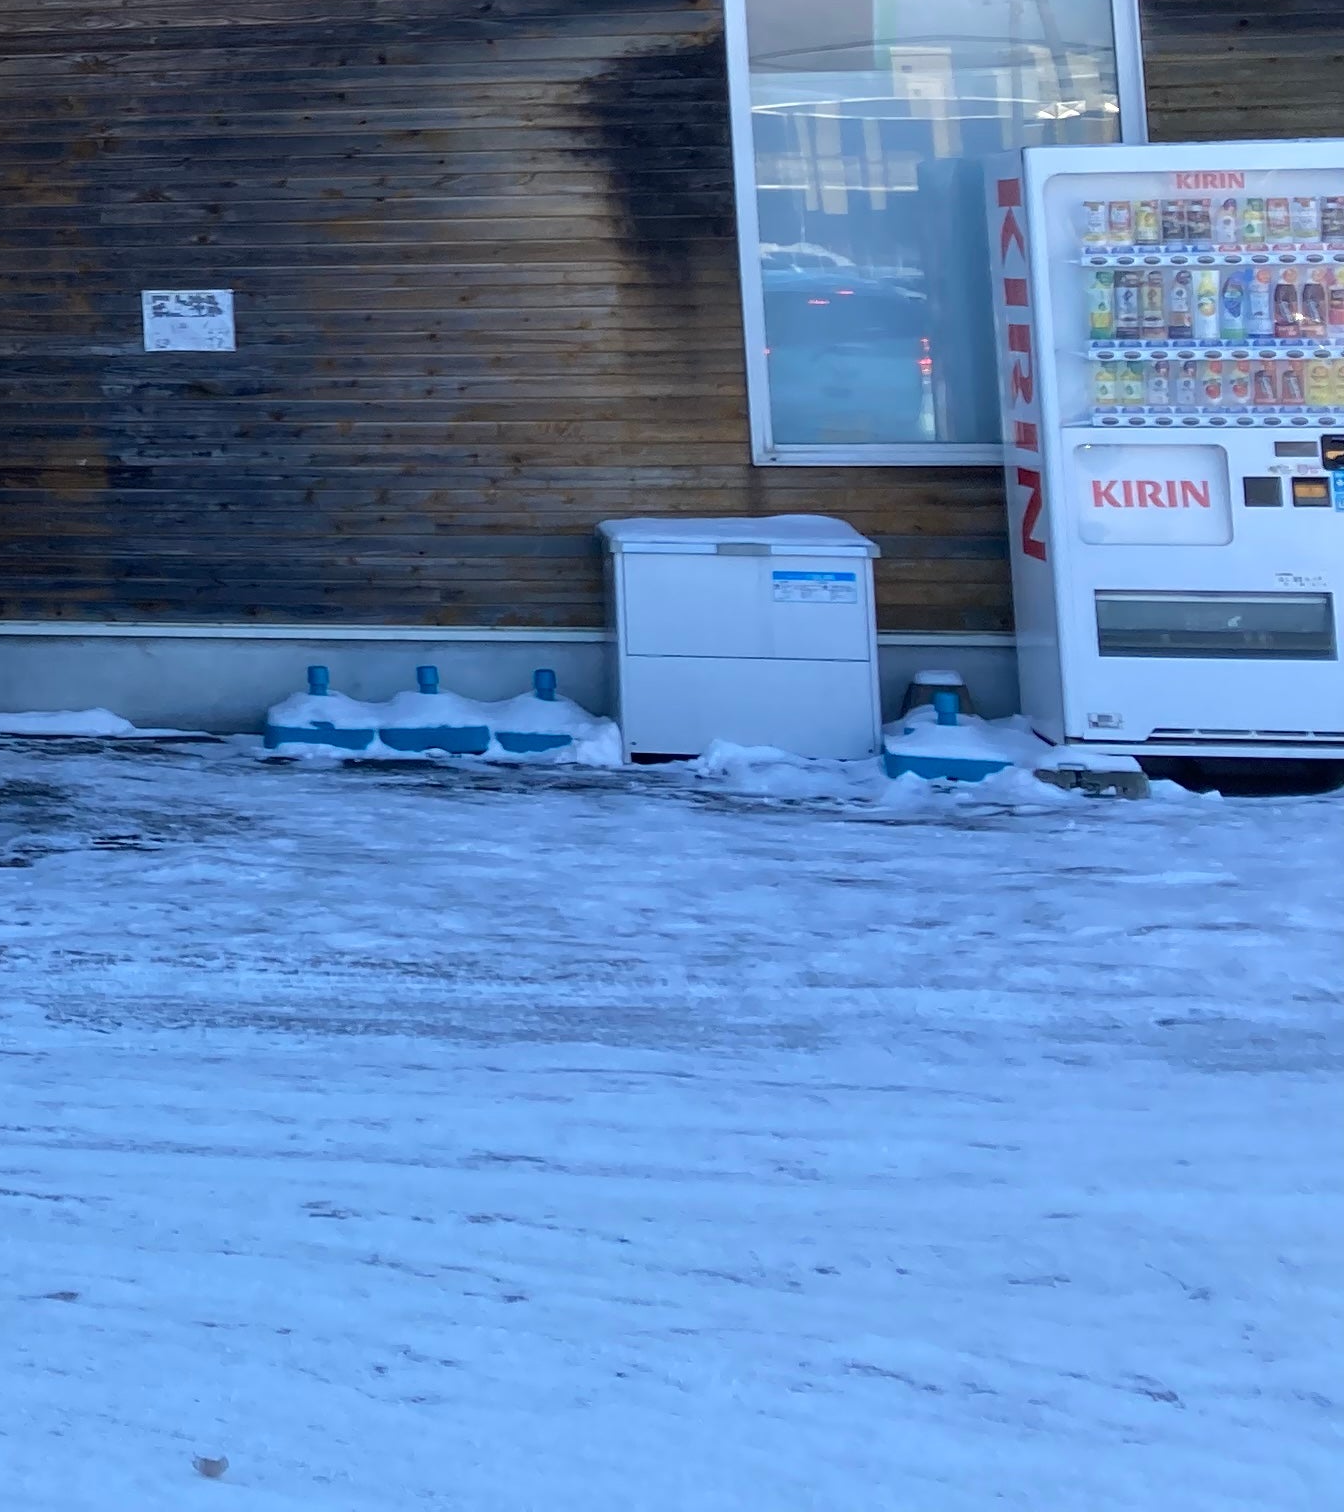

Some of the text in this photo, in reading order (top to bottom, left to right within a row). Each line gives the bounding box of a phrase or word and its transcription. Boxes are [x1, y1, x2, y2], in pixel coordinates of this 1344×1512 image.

[1175, 172, 1246, 190] KIRIN
[997, 178, 1048, 563] KIRIN
[1090, 478, 1211, 510] KIRIN
